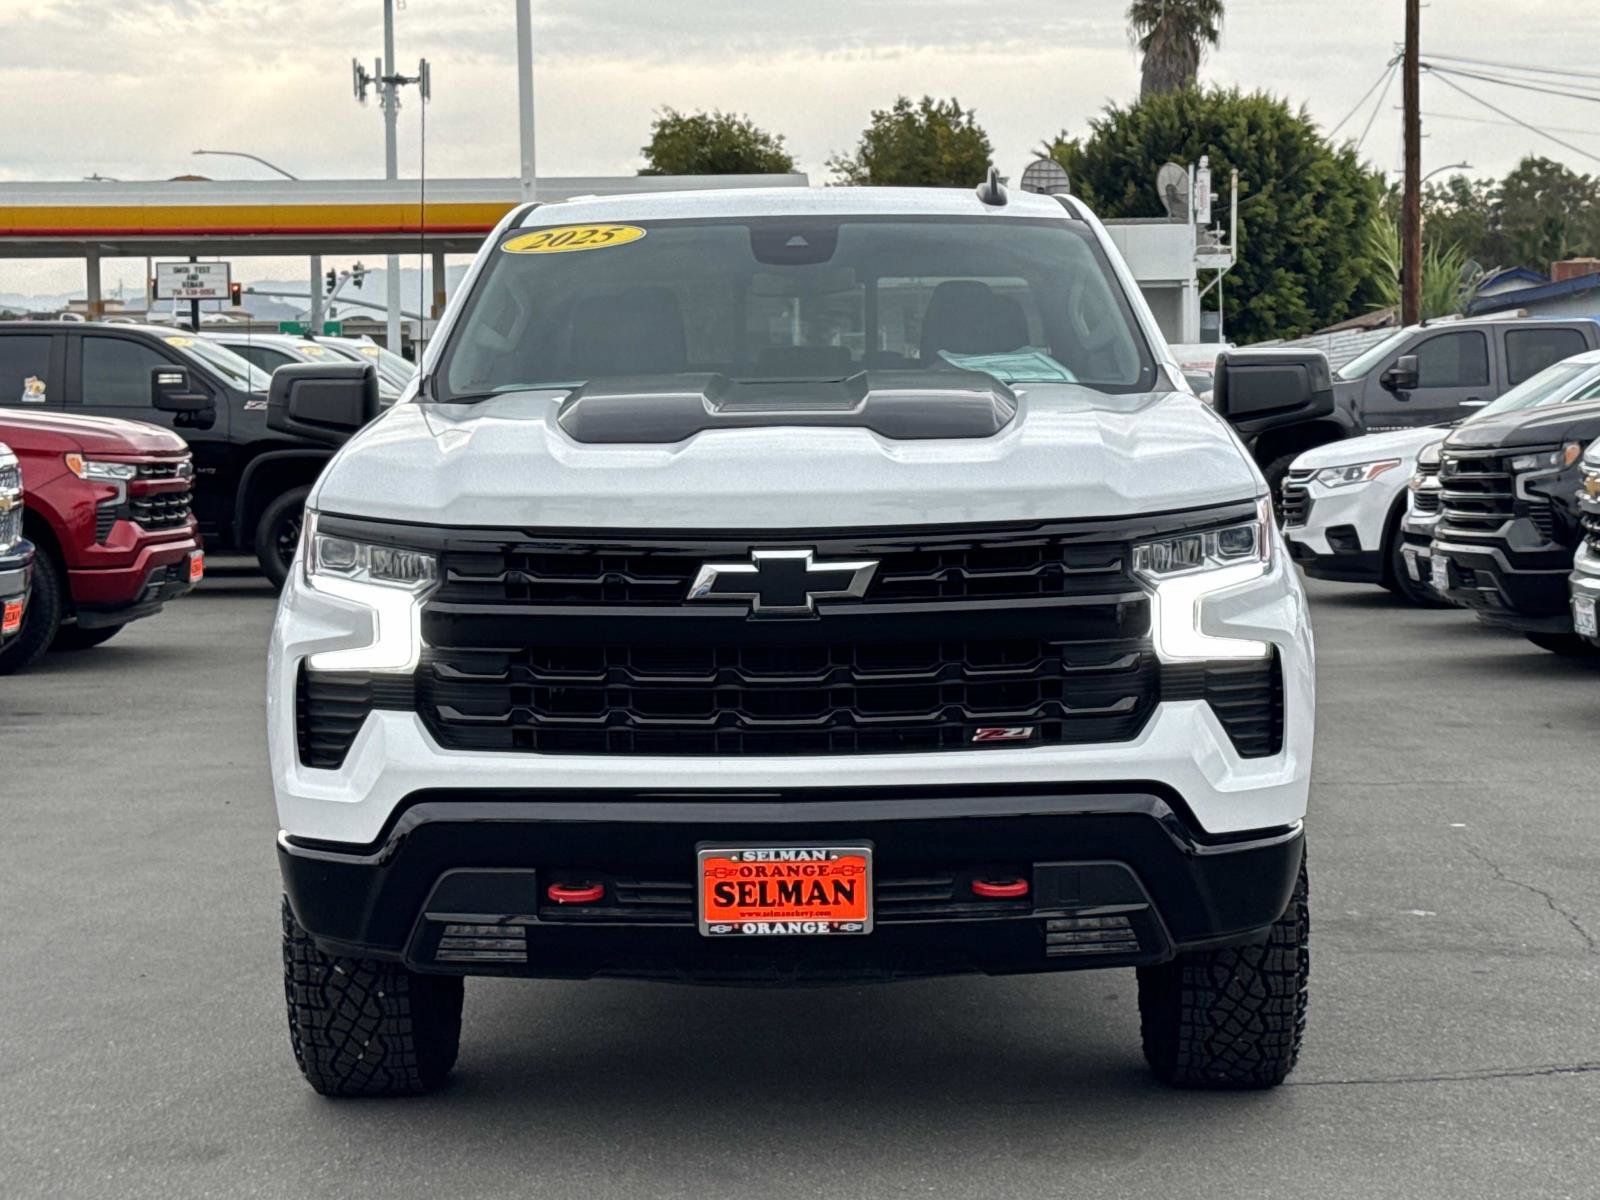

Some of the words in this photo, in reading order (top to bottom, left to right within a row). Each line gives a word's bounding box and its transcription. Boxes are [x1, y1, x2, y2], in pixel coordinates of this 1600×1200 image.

[522, 227, 625, 250] 2025
[972, 727, 1035, 742] Z71
[742, 850, 827, 862] SELMAN
[739, 865, 831, 878] ORANGE
[713, 879, 857, 908] SELMAN
[742, 922, 831, 934] ORANGE
